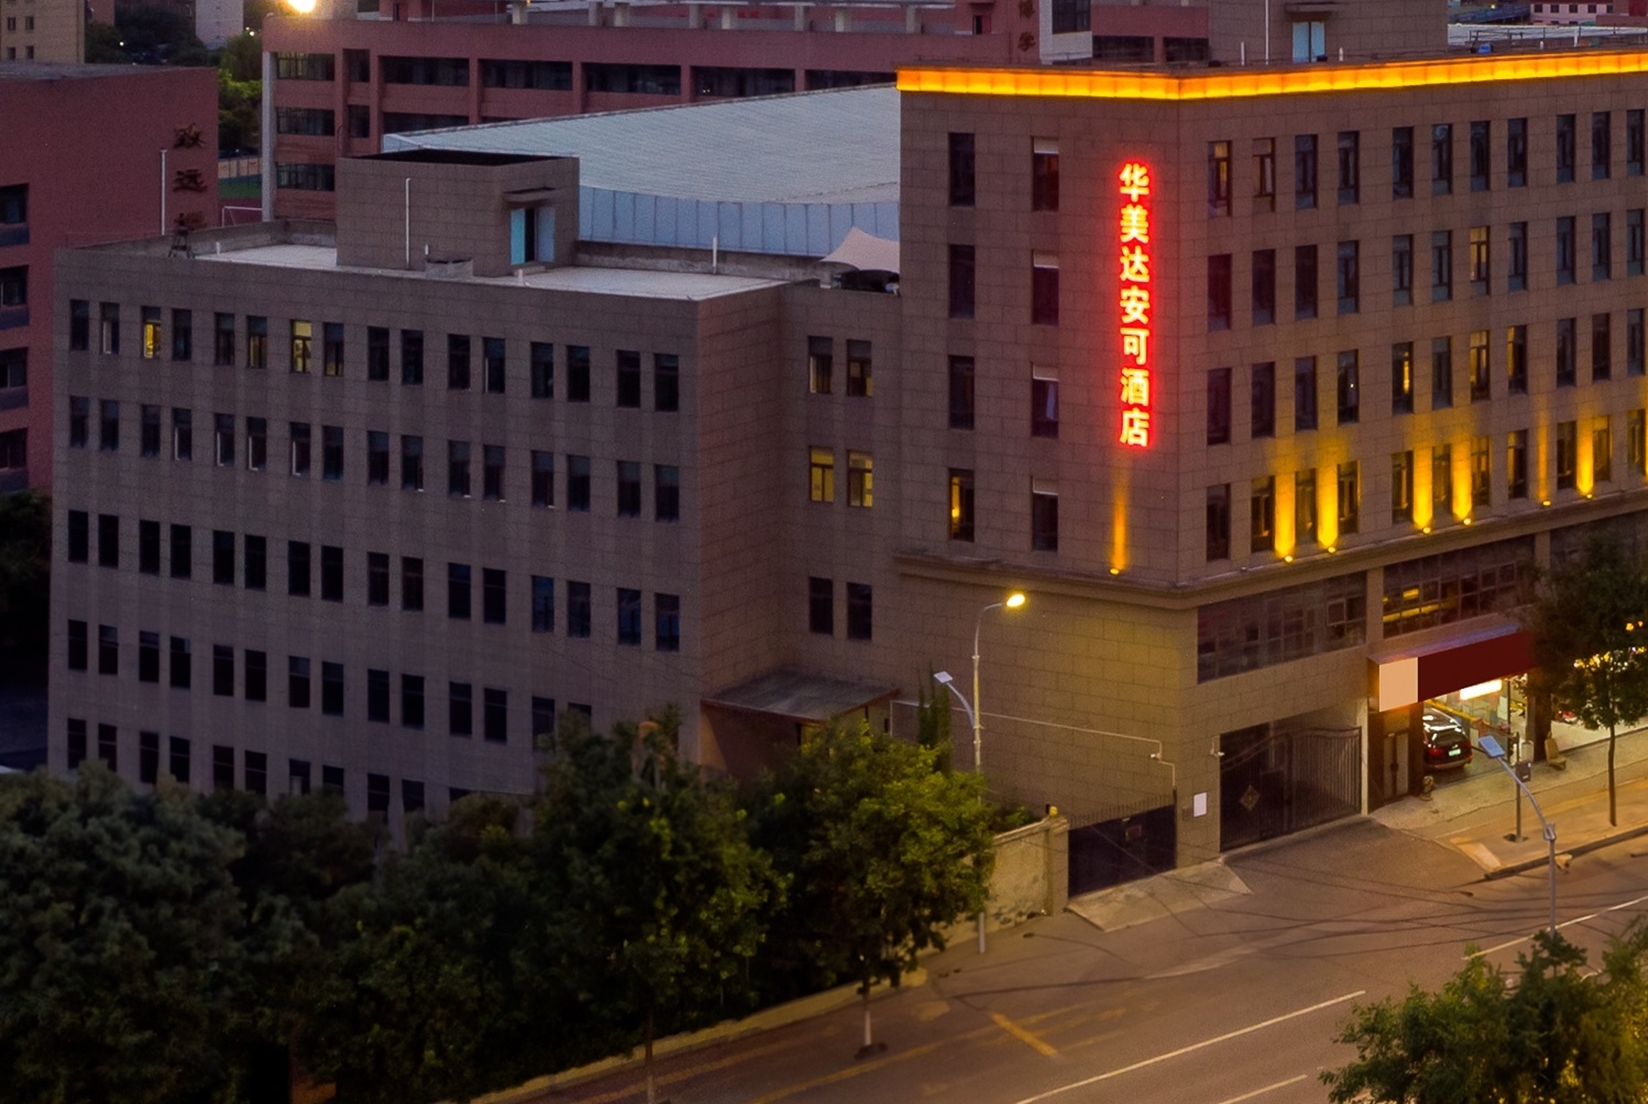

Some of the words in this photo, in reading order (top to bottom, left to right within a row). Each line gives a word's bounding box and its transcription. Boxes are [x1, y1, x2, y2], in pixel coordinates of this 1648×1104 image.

[1119, 162, 1150, 447] 华美达安可酒店
